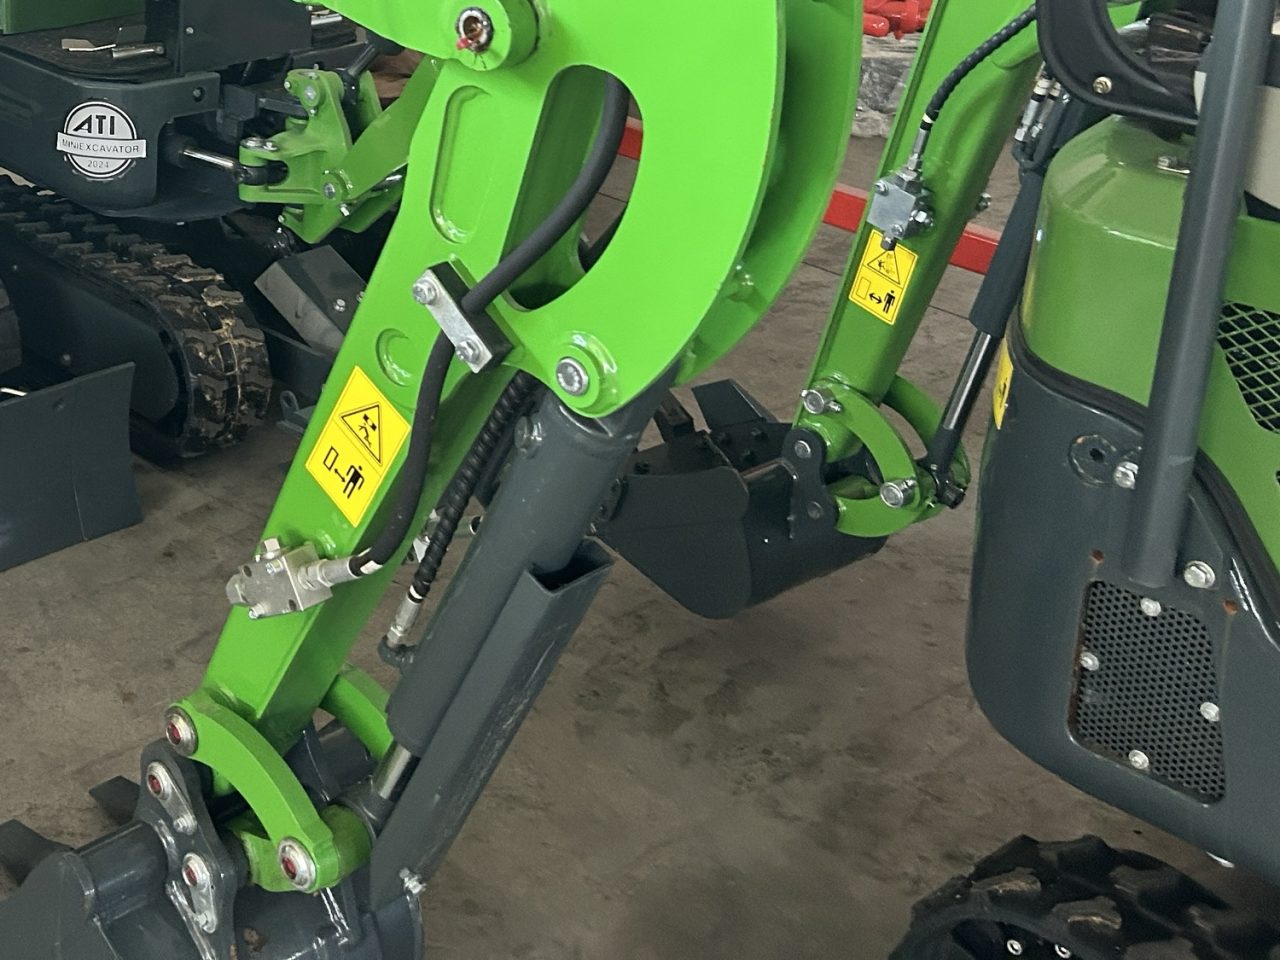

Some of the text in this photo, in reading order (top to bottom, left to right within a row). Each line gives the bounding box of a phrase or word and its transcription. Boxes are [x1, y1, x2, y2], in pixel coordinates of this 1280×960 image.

[73, 114, 115, 135] ATI
[62, 138, 139, 153] MINIEXCAVATOR
[87, 160, 109, 169] 2024
